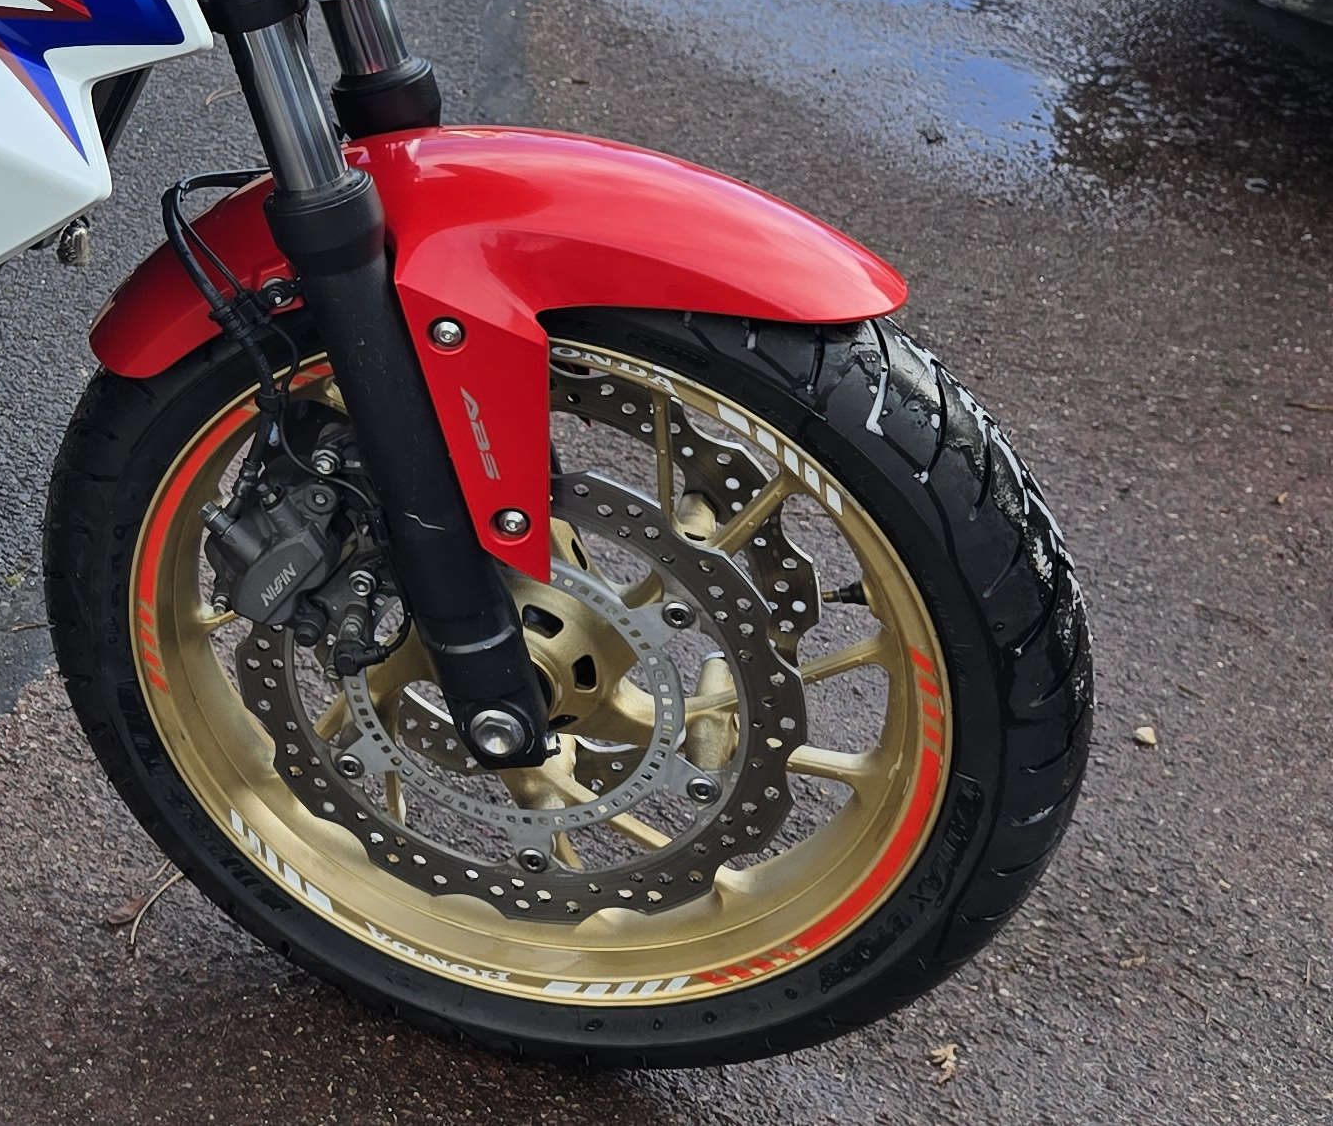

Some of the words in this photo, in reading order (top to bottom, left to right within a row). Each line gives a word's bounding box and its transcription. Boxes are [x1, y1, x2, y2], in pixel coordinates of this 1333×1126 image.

[551, 346, 680, 398] ONDA
[459, 385, 502, 481] ABS
[260, 562, 297, 607] NISSIN
[364, 920, 511, 982] HONDA
